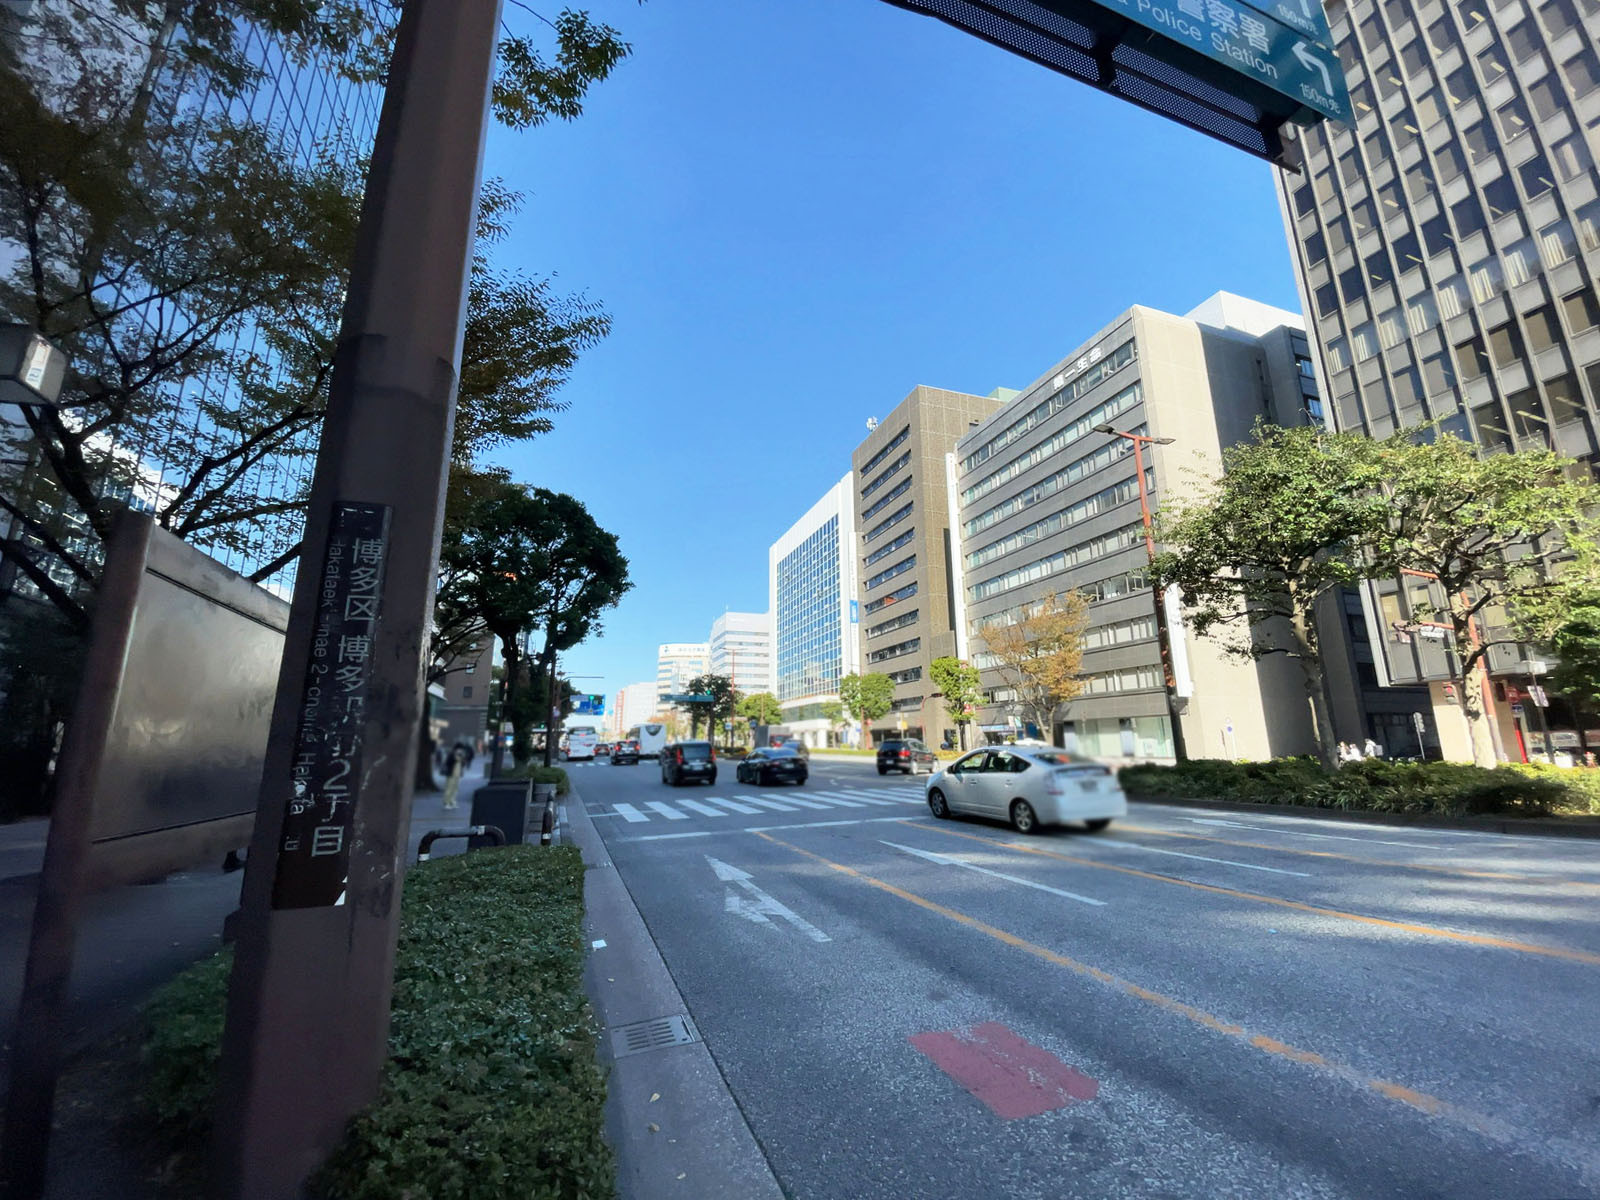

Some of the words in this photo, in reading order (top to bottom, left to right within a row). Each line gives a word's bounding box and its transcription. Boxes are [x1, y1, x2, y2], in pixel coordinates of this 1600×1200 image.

[1137, 0, 1202, 41] Police
[1211, 32, 1278, 79] Station
[344, 538, 385, 622] 博多区
